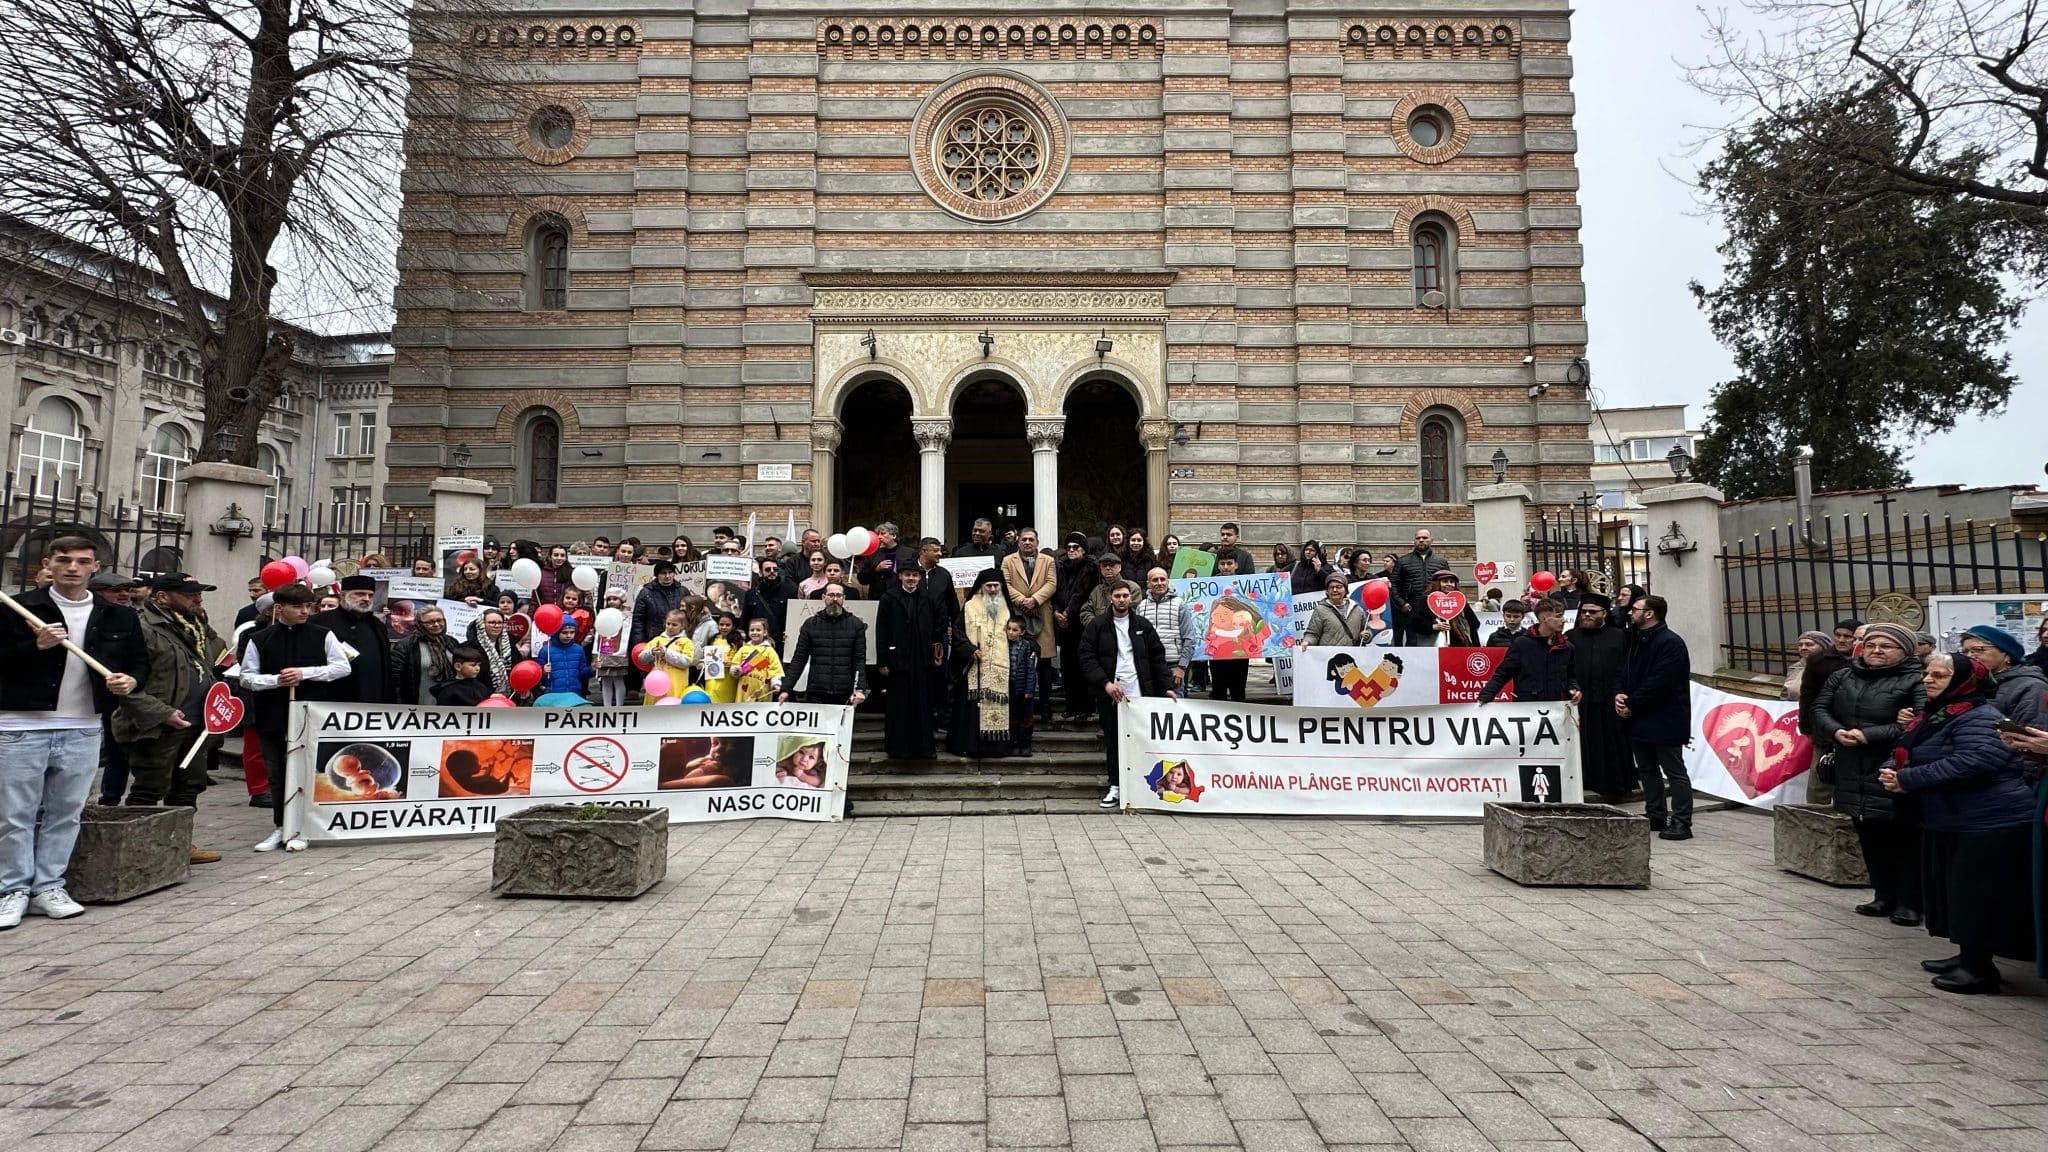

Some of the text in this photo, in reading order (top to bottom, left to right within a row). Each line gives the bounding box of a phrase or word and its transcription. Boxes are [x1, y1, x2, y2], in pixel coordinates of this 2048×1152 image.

[1190, 581, 1219, 597] PRO
[321, 708, 819, 736] ADEVĂRAȚII PĂRINȚI NASC COPII
[1299, 716, 1436, 746] PENTRU
[1446, 709, 1560, 758] VIAȚĂ
[1211, 771, 1508, 799] ROMÂNIA PLÂNGE PRUNCII AVORTAȚI
[328, 794, 821, 832] ADEVĂRAȚII NASC COPII
